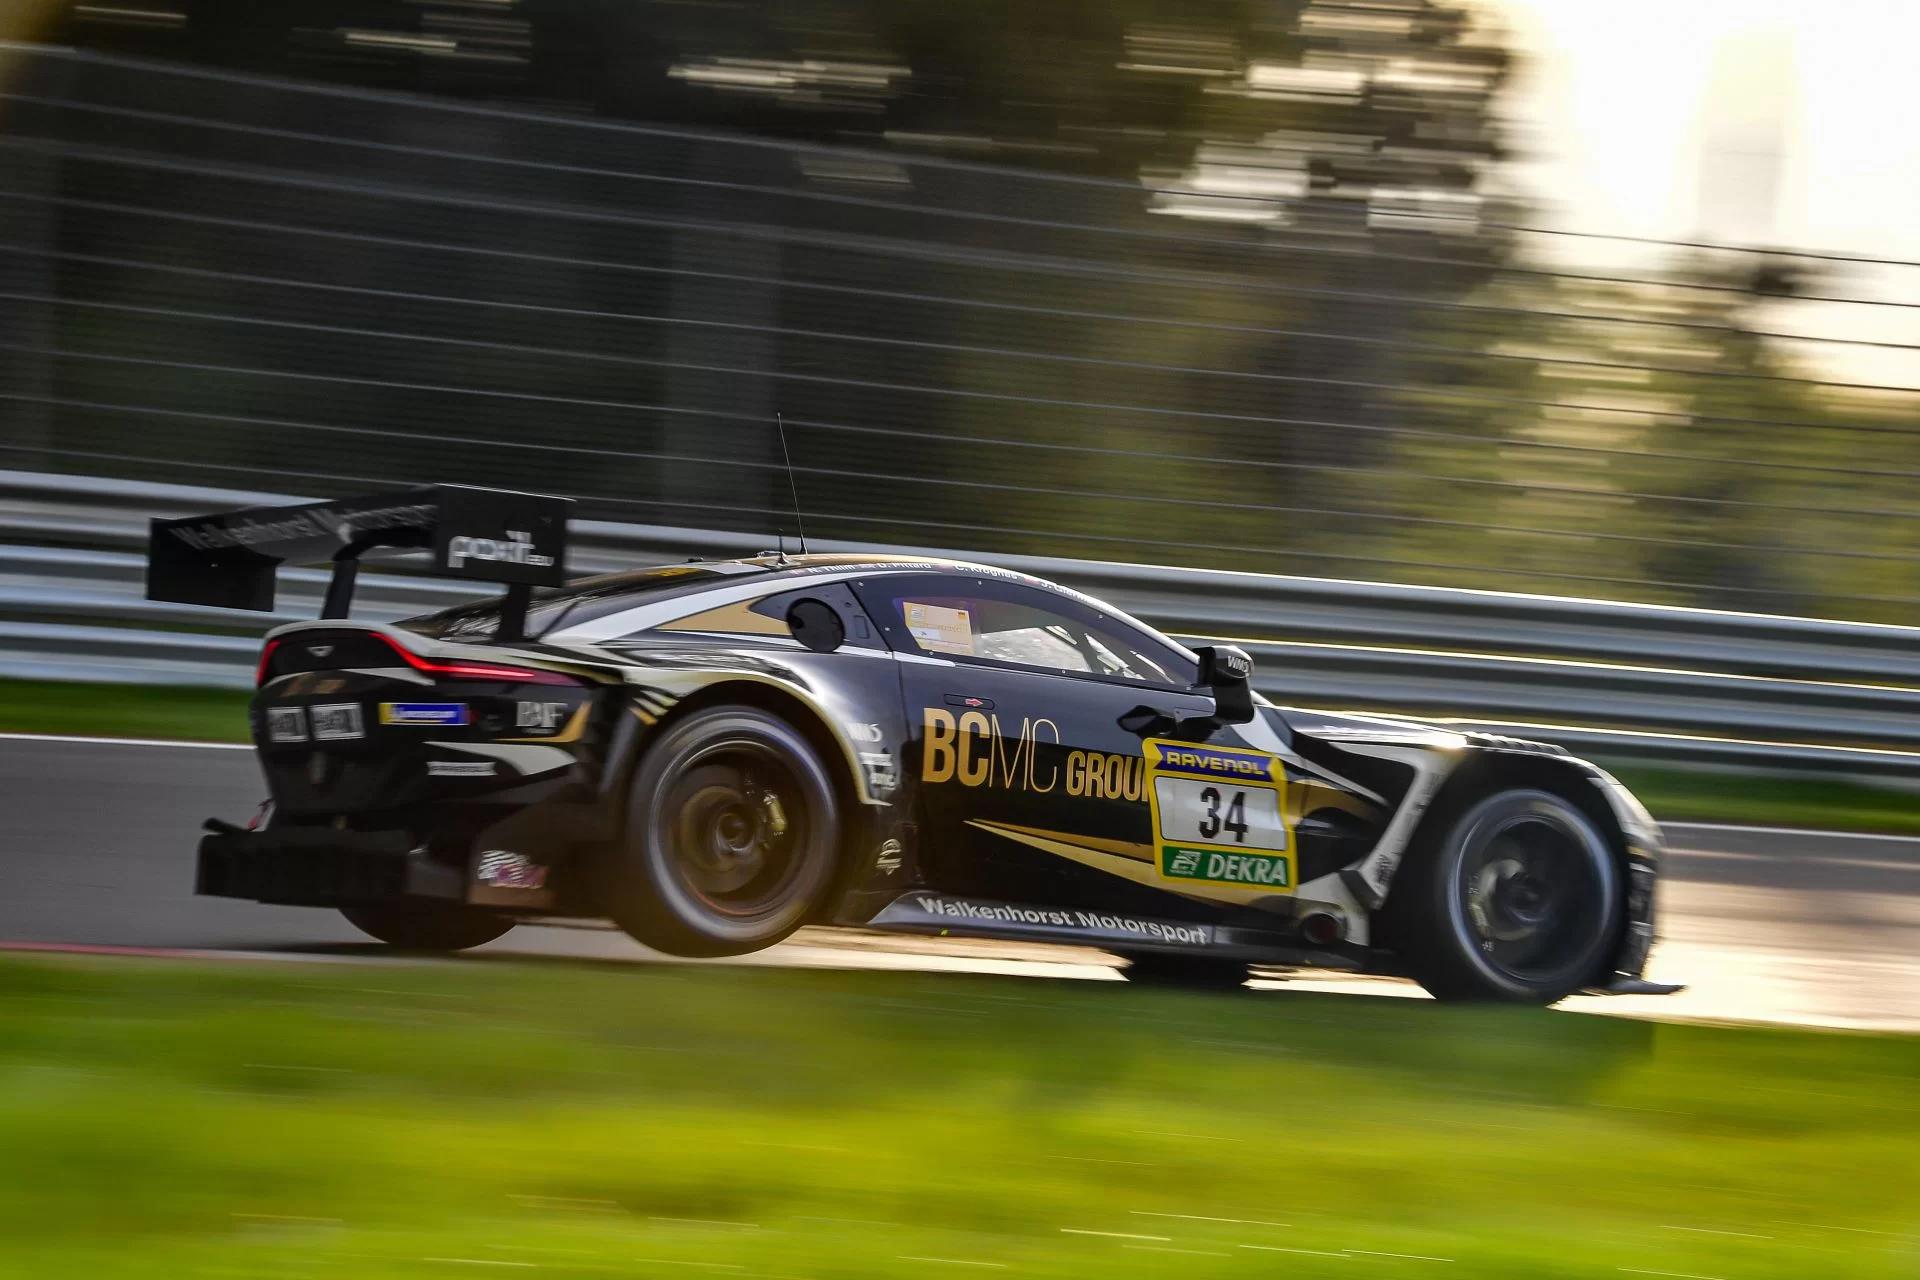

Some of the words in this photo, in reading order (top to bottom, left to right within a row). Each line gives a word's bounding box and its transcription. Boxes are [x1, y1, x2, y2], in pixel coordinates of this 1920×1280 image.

[922, 708, 1060, 793] BCMC
[1166, 751, 1265, 776] RAVENOL
[1198, 786, 1249, 843] 34
[1206, 854, 1287, 885] DEKRA
[916, 897, 1074, 926] Walkenhorst
[1074, 911, 1207, 945] Motorsport
